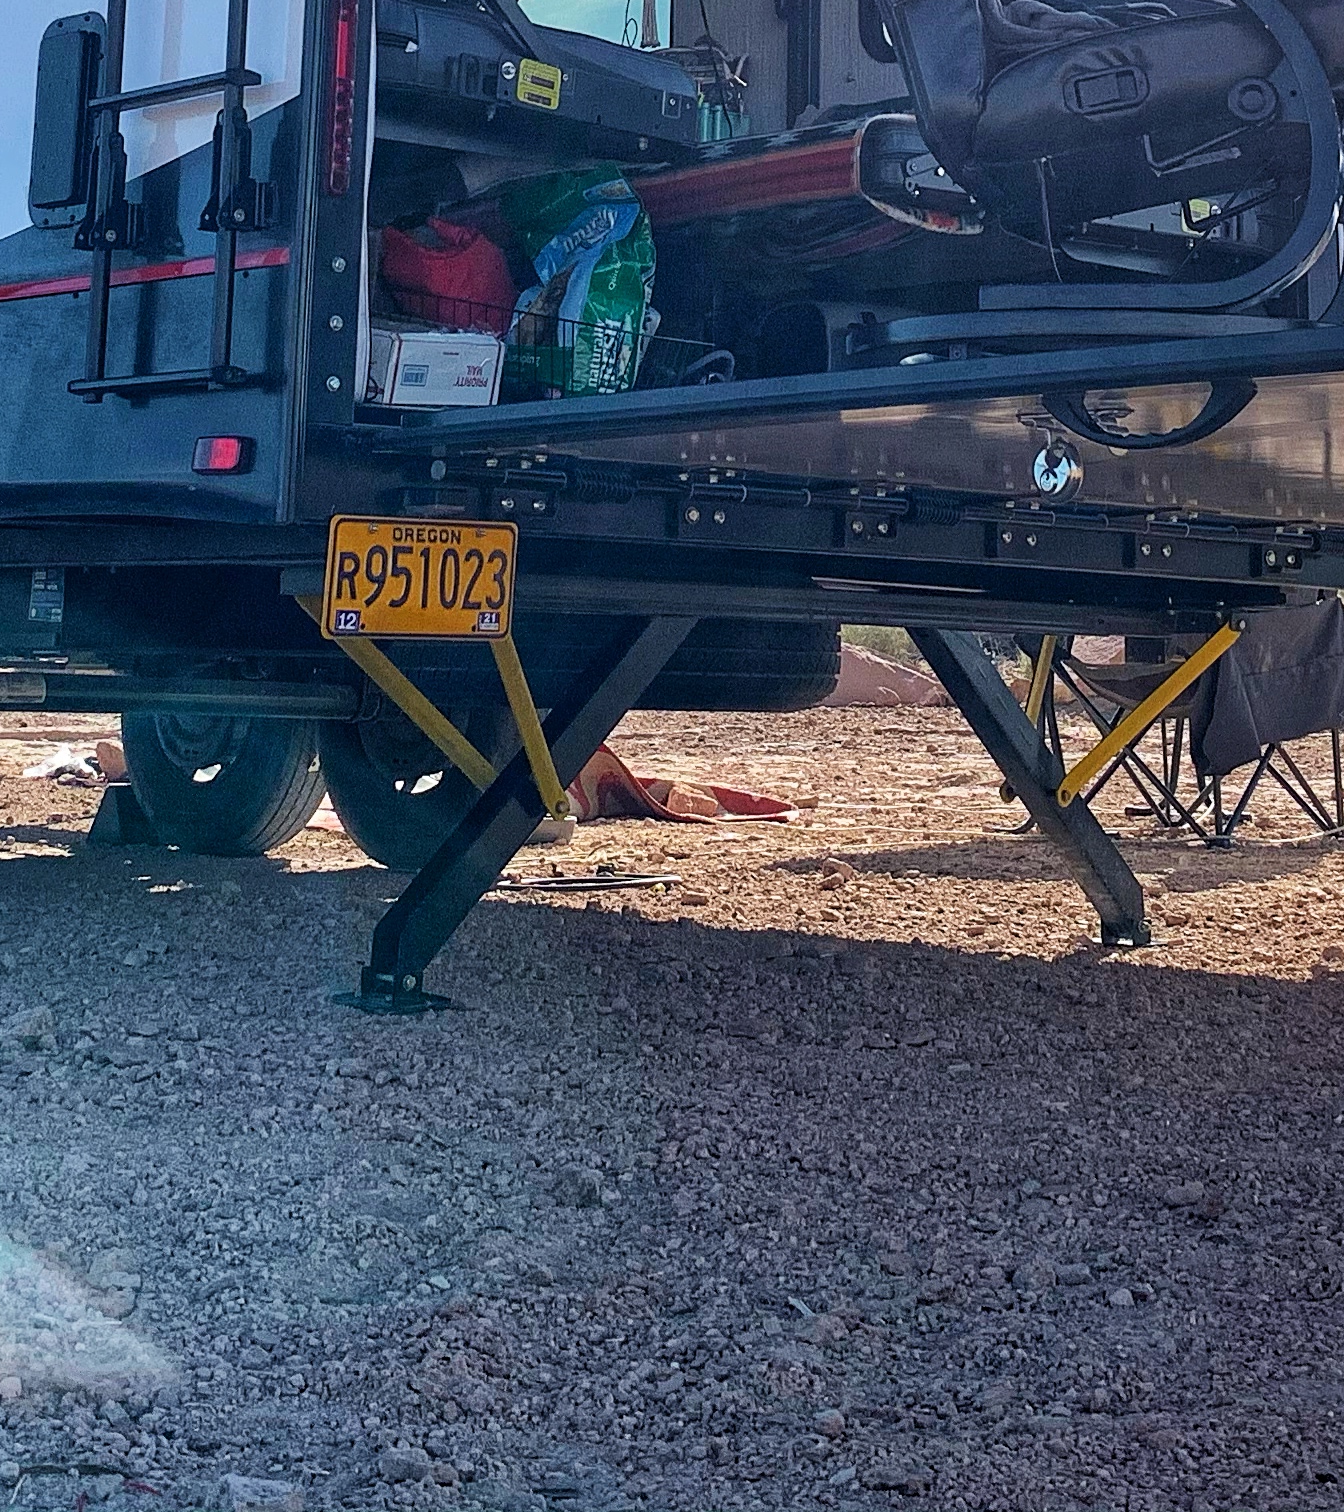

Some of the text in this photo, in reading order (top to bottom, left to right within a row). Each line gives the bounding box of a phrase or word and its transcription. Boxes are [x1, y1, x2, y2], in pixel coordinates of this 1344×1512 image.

[453, 377, 489, 388] PRIORITY
[392, 527, 462, 545] OREGON
[336, 544, 507, 610] R951023
[338, 613, 358, 630] 12
[483, 612, 497, 623] 21
